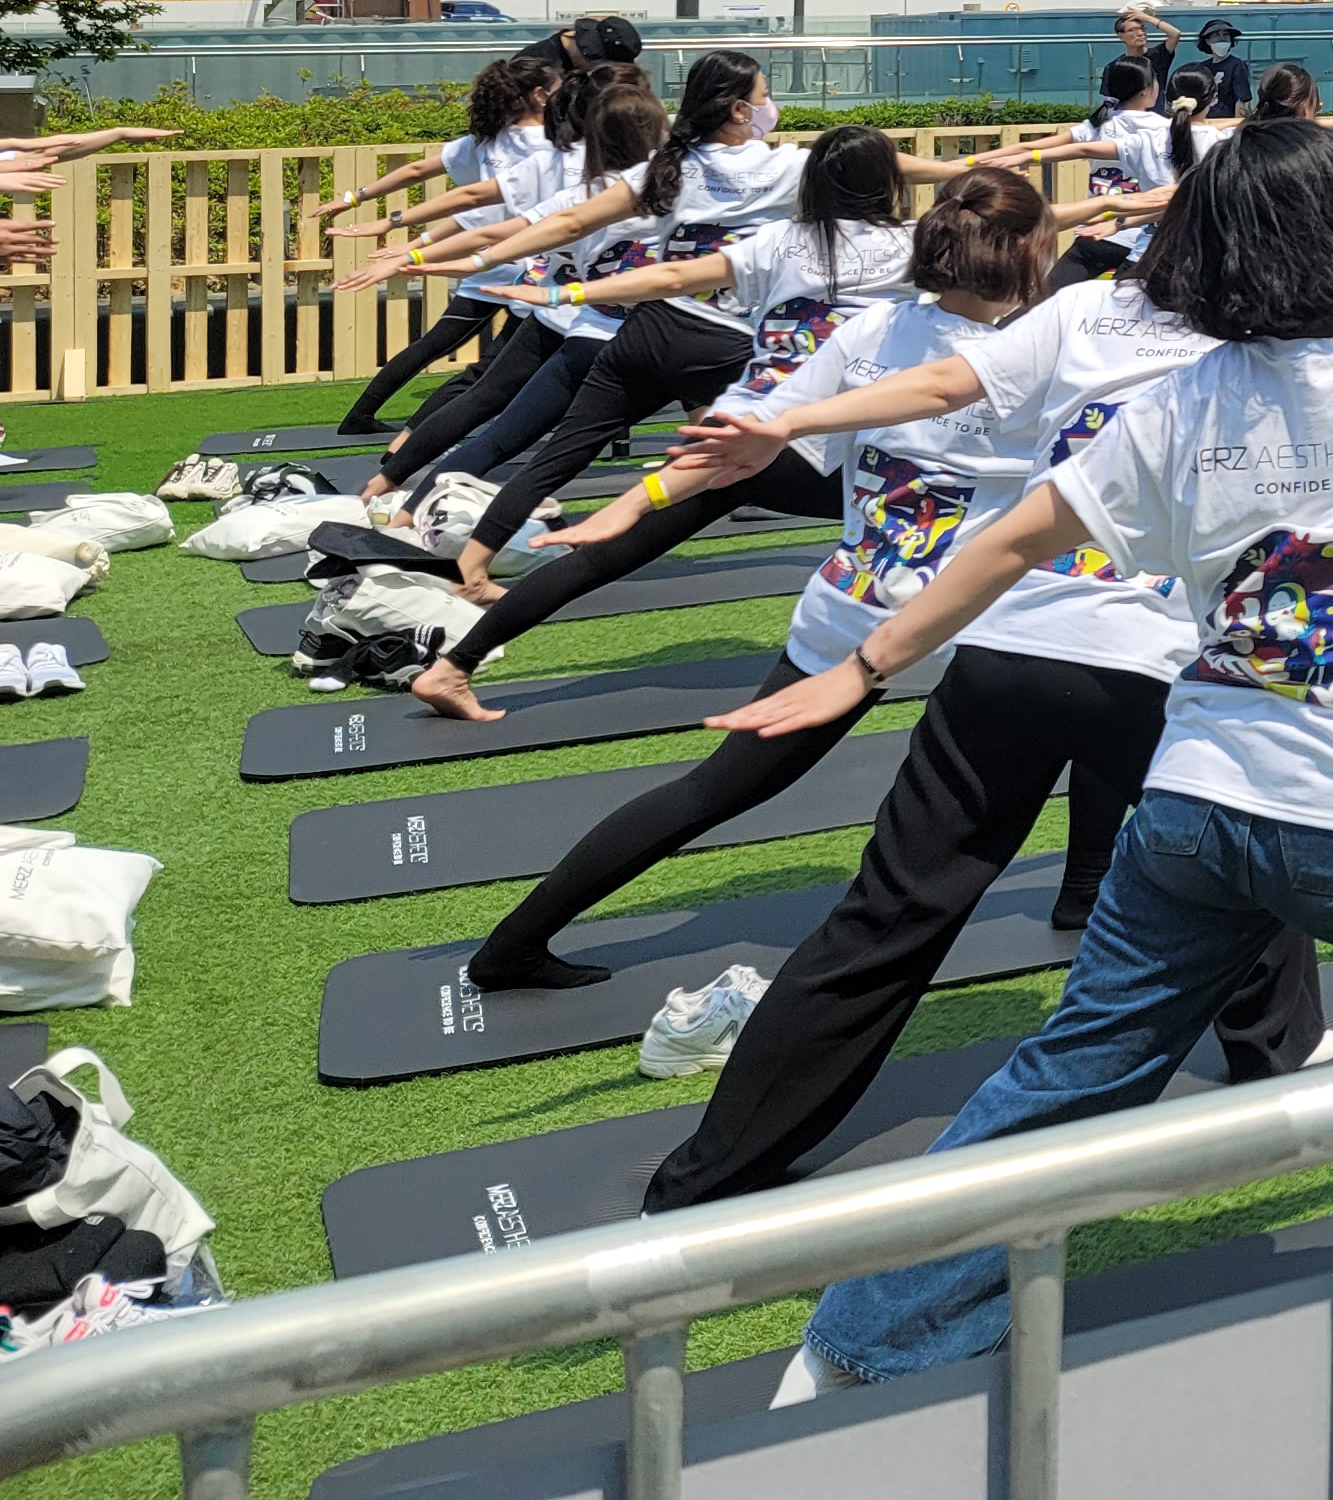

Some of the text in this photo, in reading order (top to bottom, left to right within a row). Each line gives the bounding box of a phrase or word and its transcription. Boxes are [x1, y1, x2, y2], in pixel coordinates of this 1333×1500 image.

[1077, 317, 1140, 338] MERZ
[954, 423, 991, 436] TO BE
